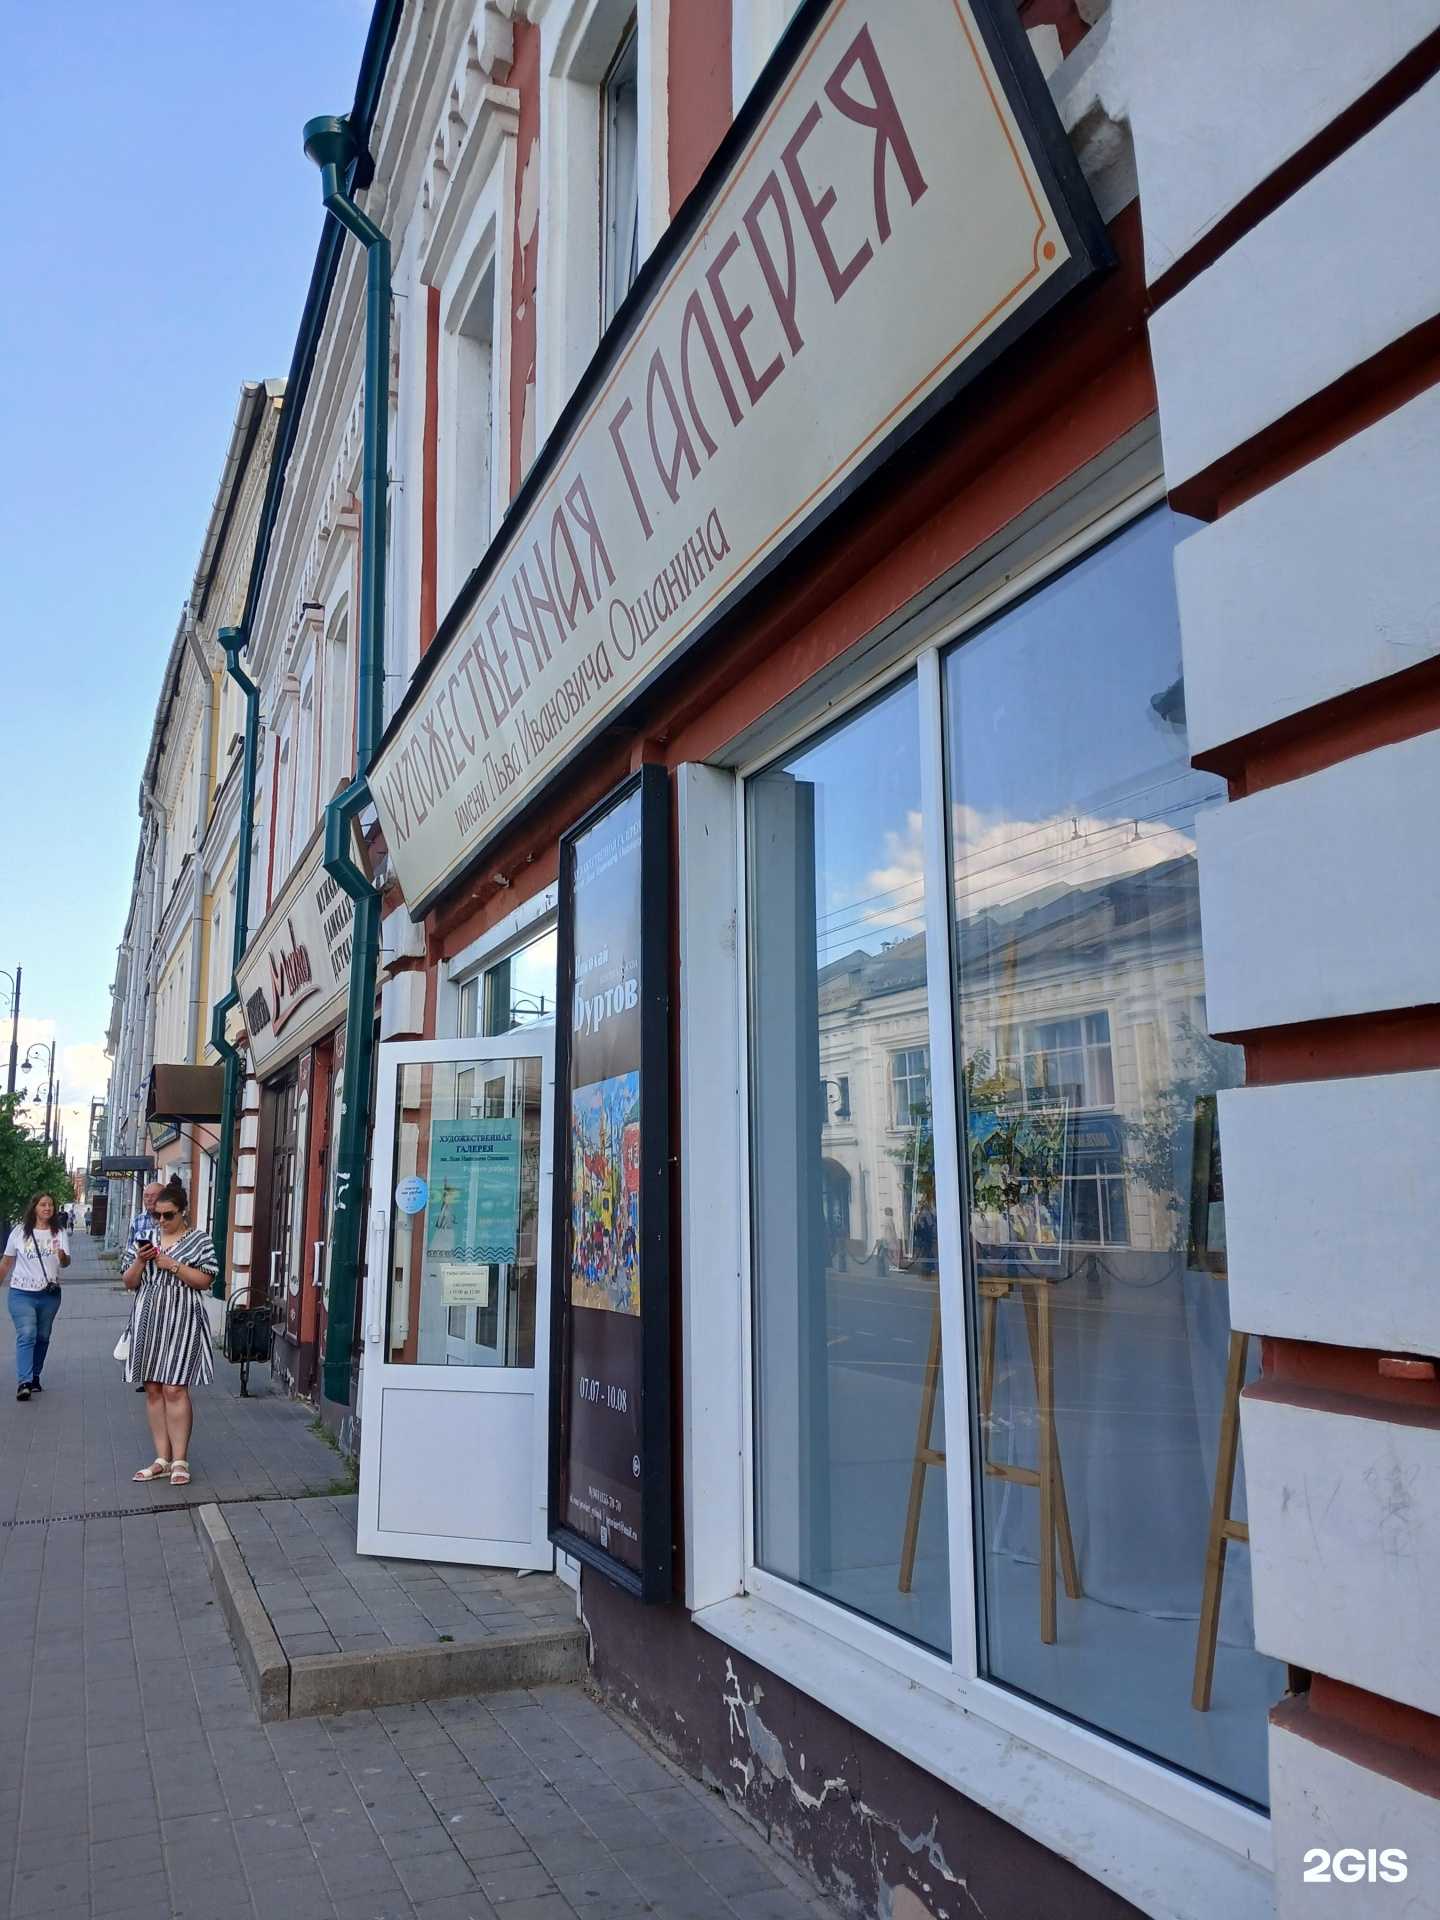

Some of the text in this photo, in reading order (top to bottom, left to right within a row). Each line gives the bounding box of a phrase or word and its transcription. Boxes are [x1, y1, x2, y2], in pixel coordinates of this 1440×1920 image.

[380, 21, 929, 850] ХУДОЖЕСТВЕННАЯ ГАЛЕРЕЯ
[454, 779, 491, 837] имени
[482, 743, 523, 796] Льва
[515, 640, 614, 766] Ивановича
[608, 506, 732, 662] Ошанина
[331, 934, 353, 984] ДЕТСК
[439, 1134, 513, 1144] ХУДОЖЕСТВЕННАЯ
[456, 1144, 495, 1153] ГАЛЕРЕЯ
[579, 1376, 600, 1404] 07.07
[607, 1384, 628, 1413] 10.08
